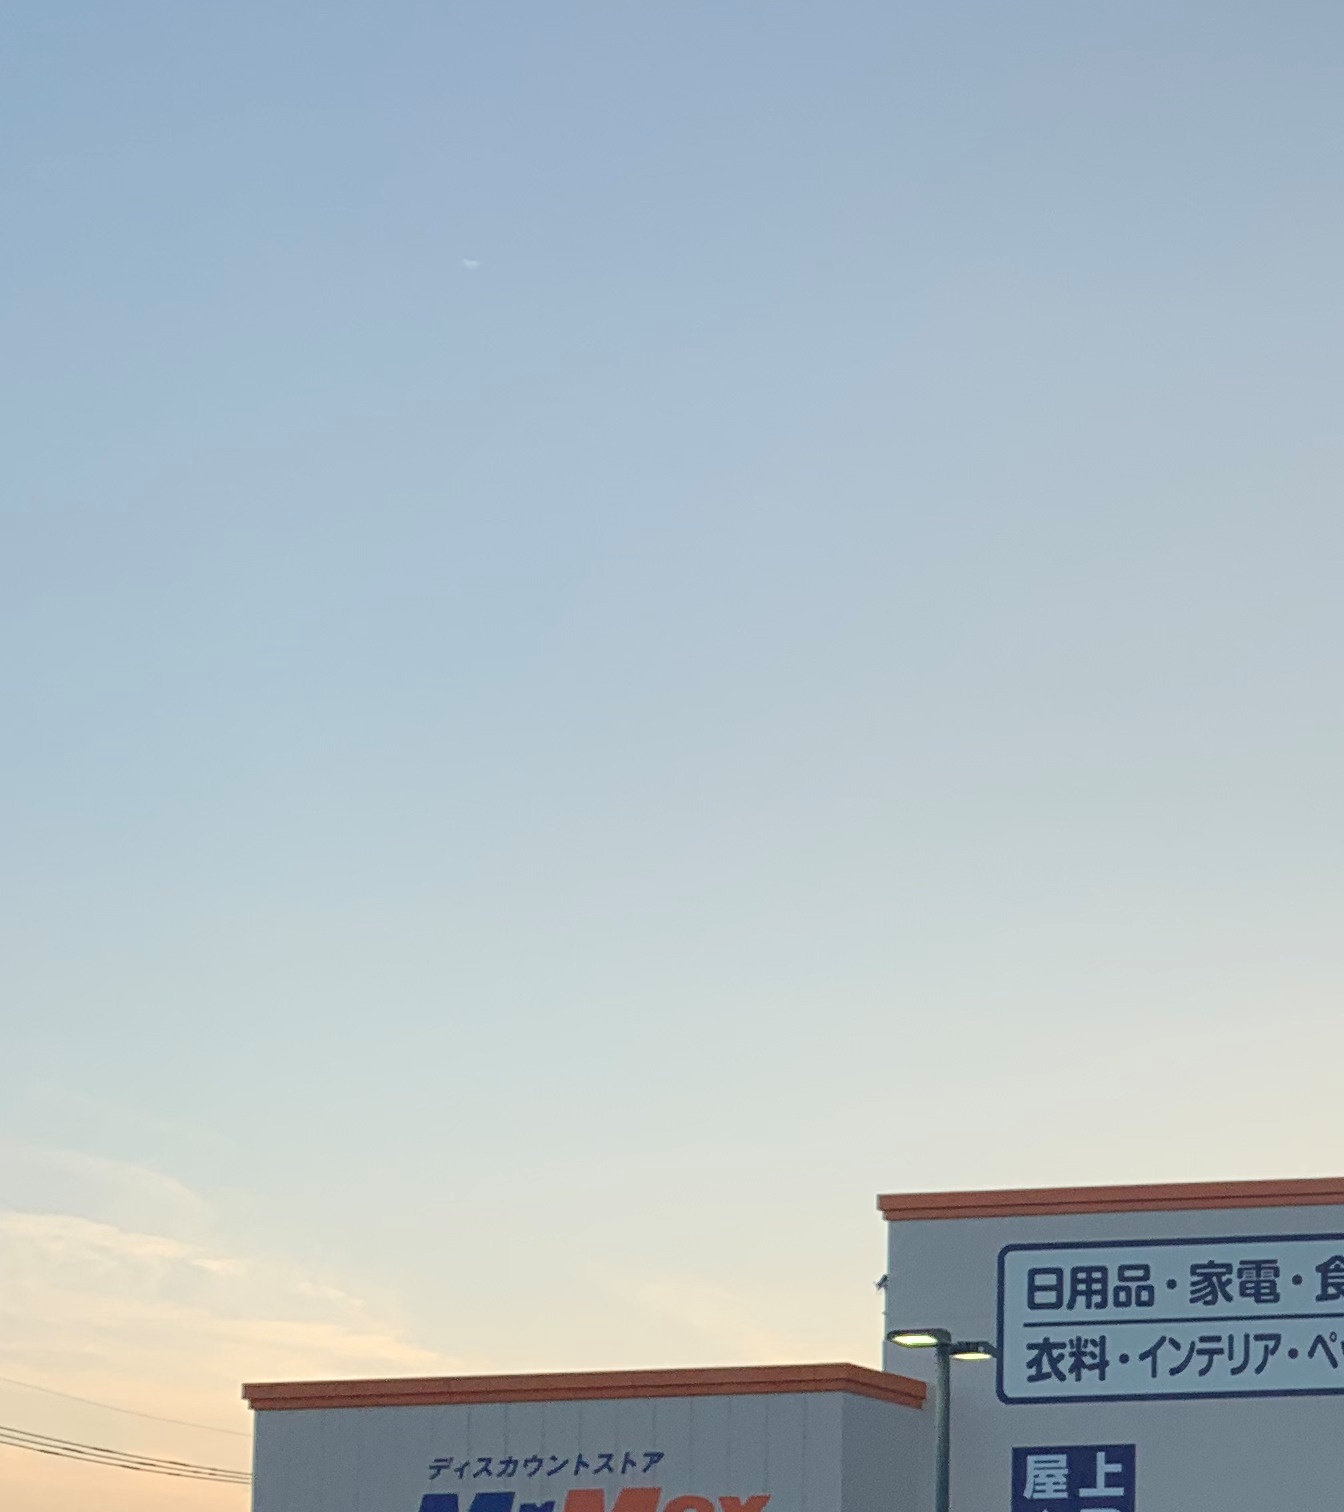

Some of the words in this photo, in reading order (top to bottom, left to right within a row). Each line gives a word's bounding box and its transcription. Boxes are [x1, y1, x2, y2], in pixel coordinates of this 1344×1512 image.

[428, 1450, 666, 1480] ディスカウントストア
[1022, 1451, 1125, 1500] 屋上
